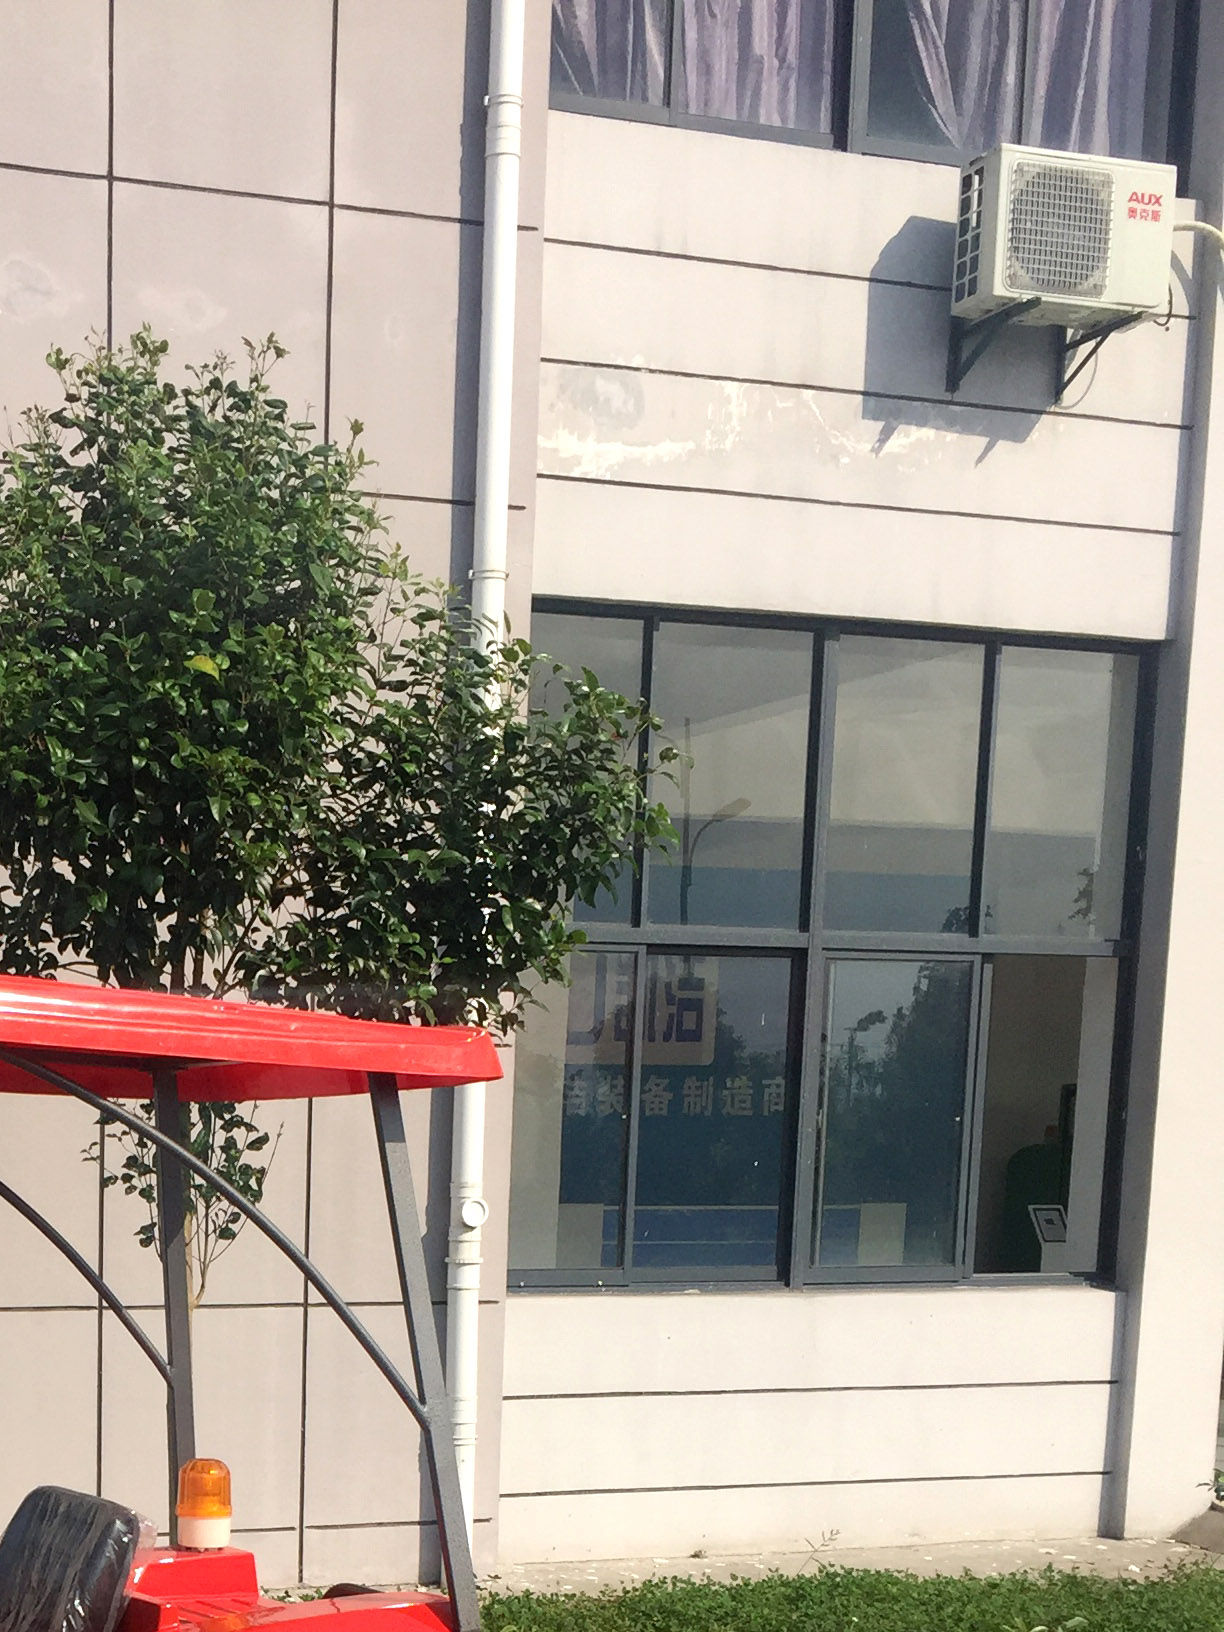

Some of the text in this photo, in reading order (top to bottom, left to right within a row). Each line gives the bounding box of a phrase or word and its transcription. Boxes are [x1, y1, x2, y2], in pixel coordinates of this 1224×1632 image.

[1128, 191, 1164, 207] AUX
[1128, 207, 1162, 222] 奥克斯
